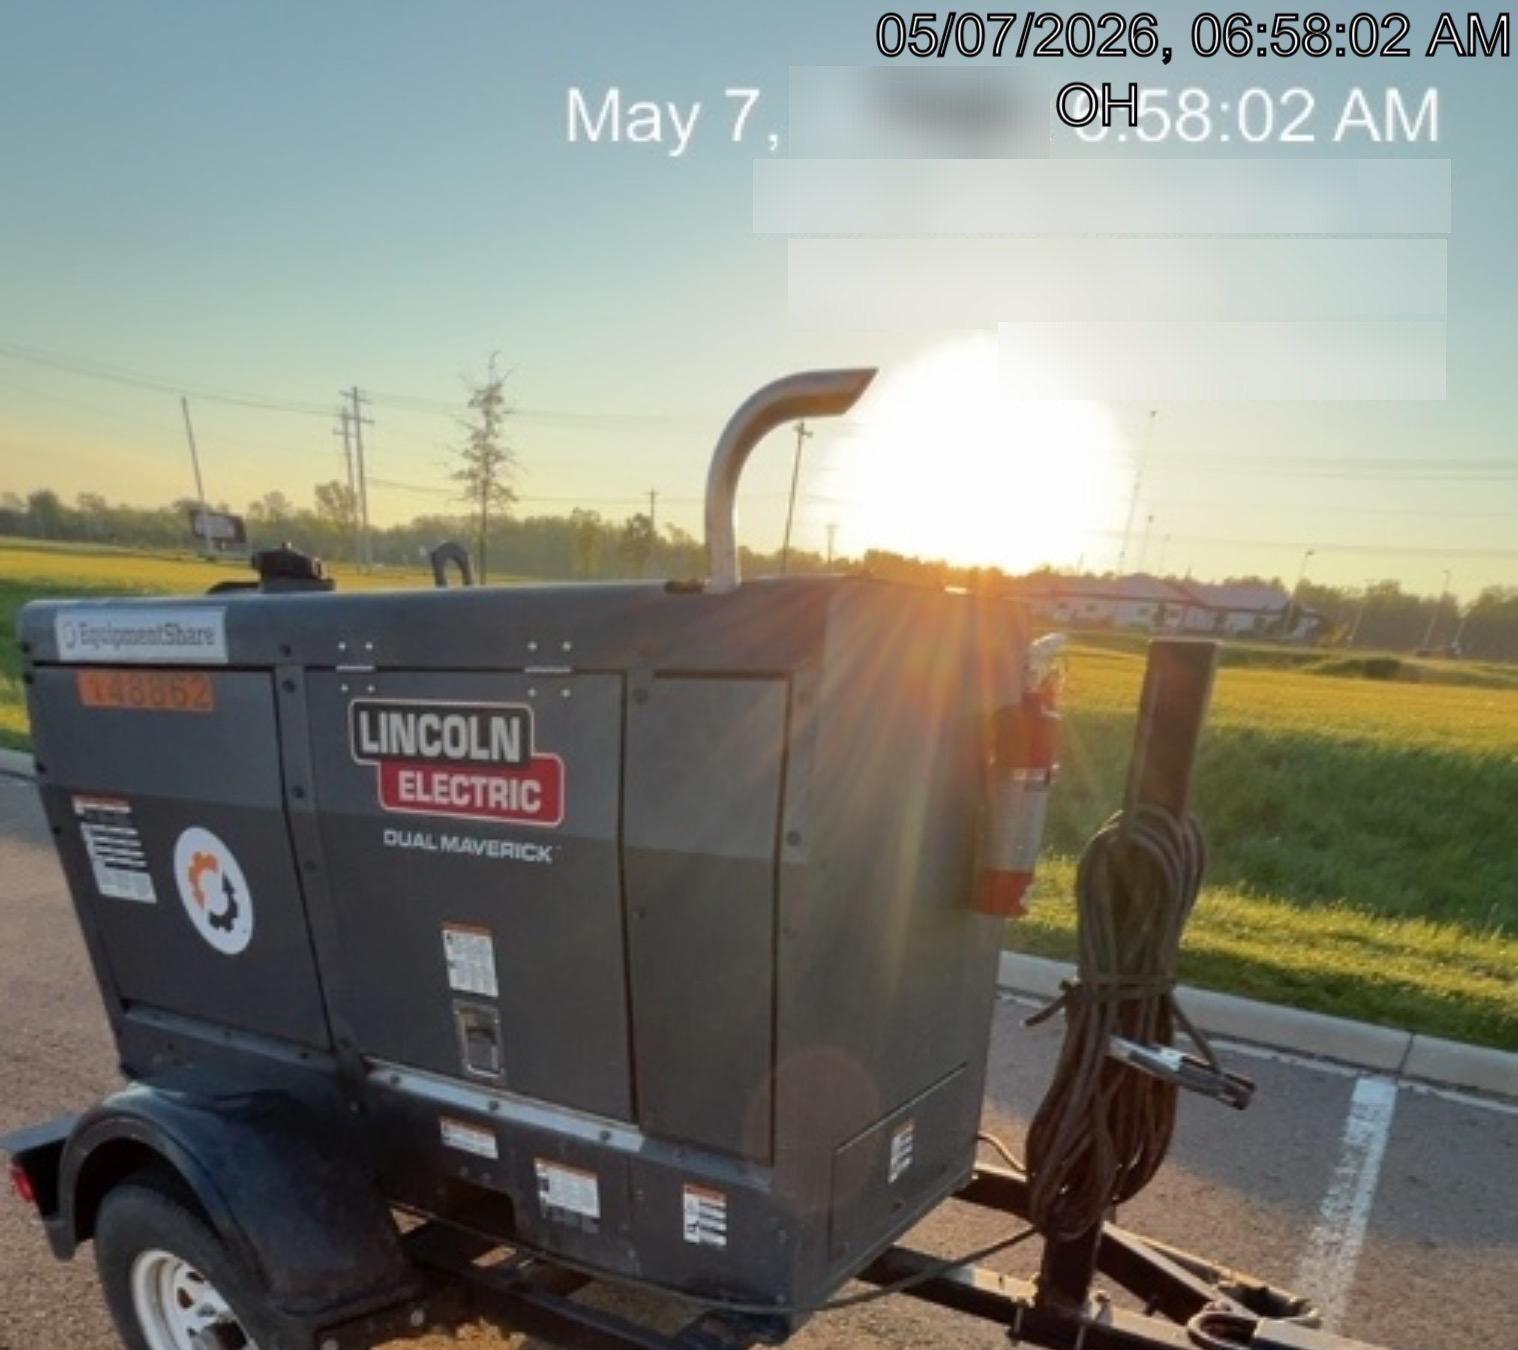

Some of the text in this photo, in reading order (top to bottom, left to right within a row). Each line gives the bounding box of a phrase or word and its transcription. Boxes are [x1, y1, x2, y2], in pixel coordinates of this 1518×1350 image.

[79, 622, 216, 649] EquipmentShare
[359, 711, 521, 763] LINCOLN
[398, 770, 542, 813] ELECTRIC
[383, 829, 553, 863] DUAL MAVERICK
